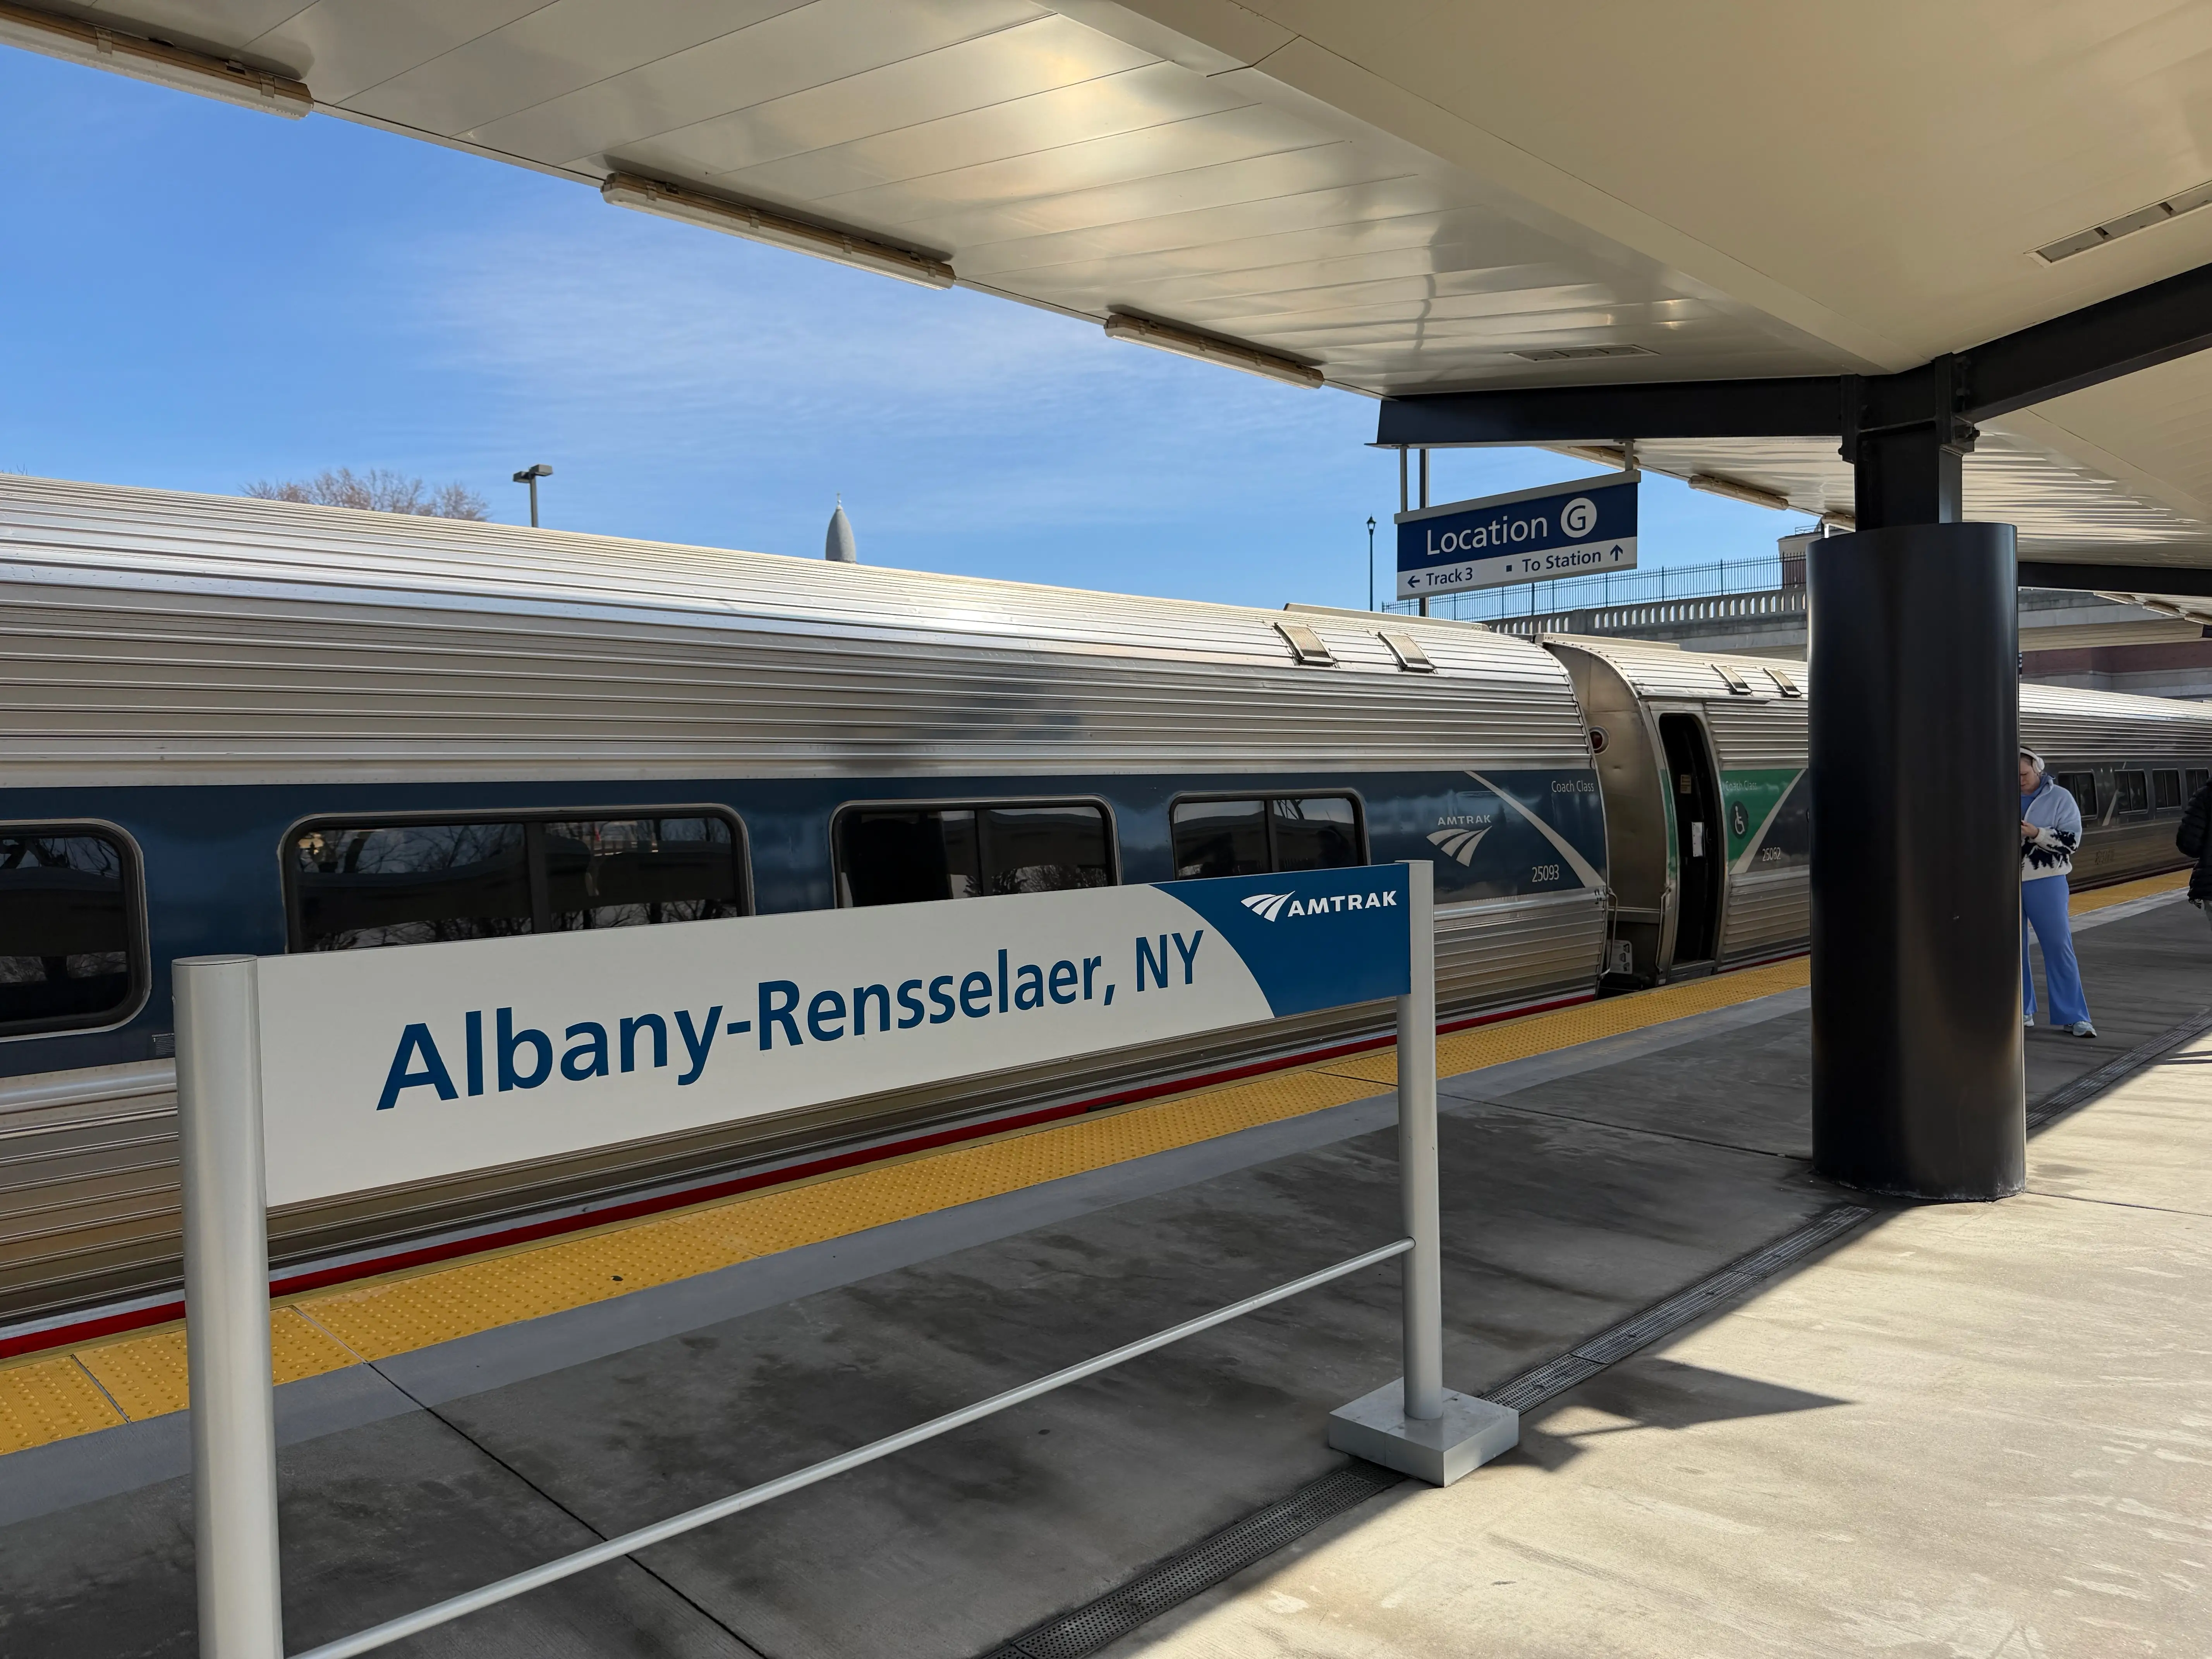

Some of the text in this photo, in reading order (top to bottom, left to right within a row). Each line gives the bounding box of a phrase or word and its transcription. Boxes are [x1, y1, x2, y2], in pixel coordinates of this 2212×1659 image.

[1427, 505, 1587, 555] Location G
[1522, 550, 1601, 572] To Station
[1426, 567, 1473, 586] Track 3
[1551, 780, 1594, 792] Coach Class
[1437, 815, 1491, 826] AMTRAK
[1762, 847, 1781, 861] 25062
[1532, 864, 1559, 882] 25093
[1288, 891, 1397, 917] AMTRAK
[376, 930, 1203, 1110] Albany-Rensselaer, NY
